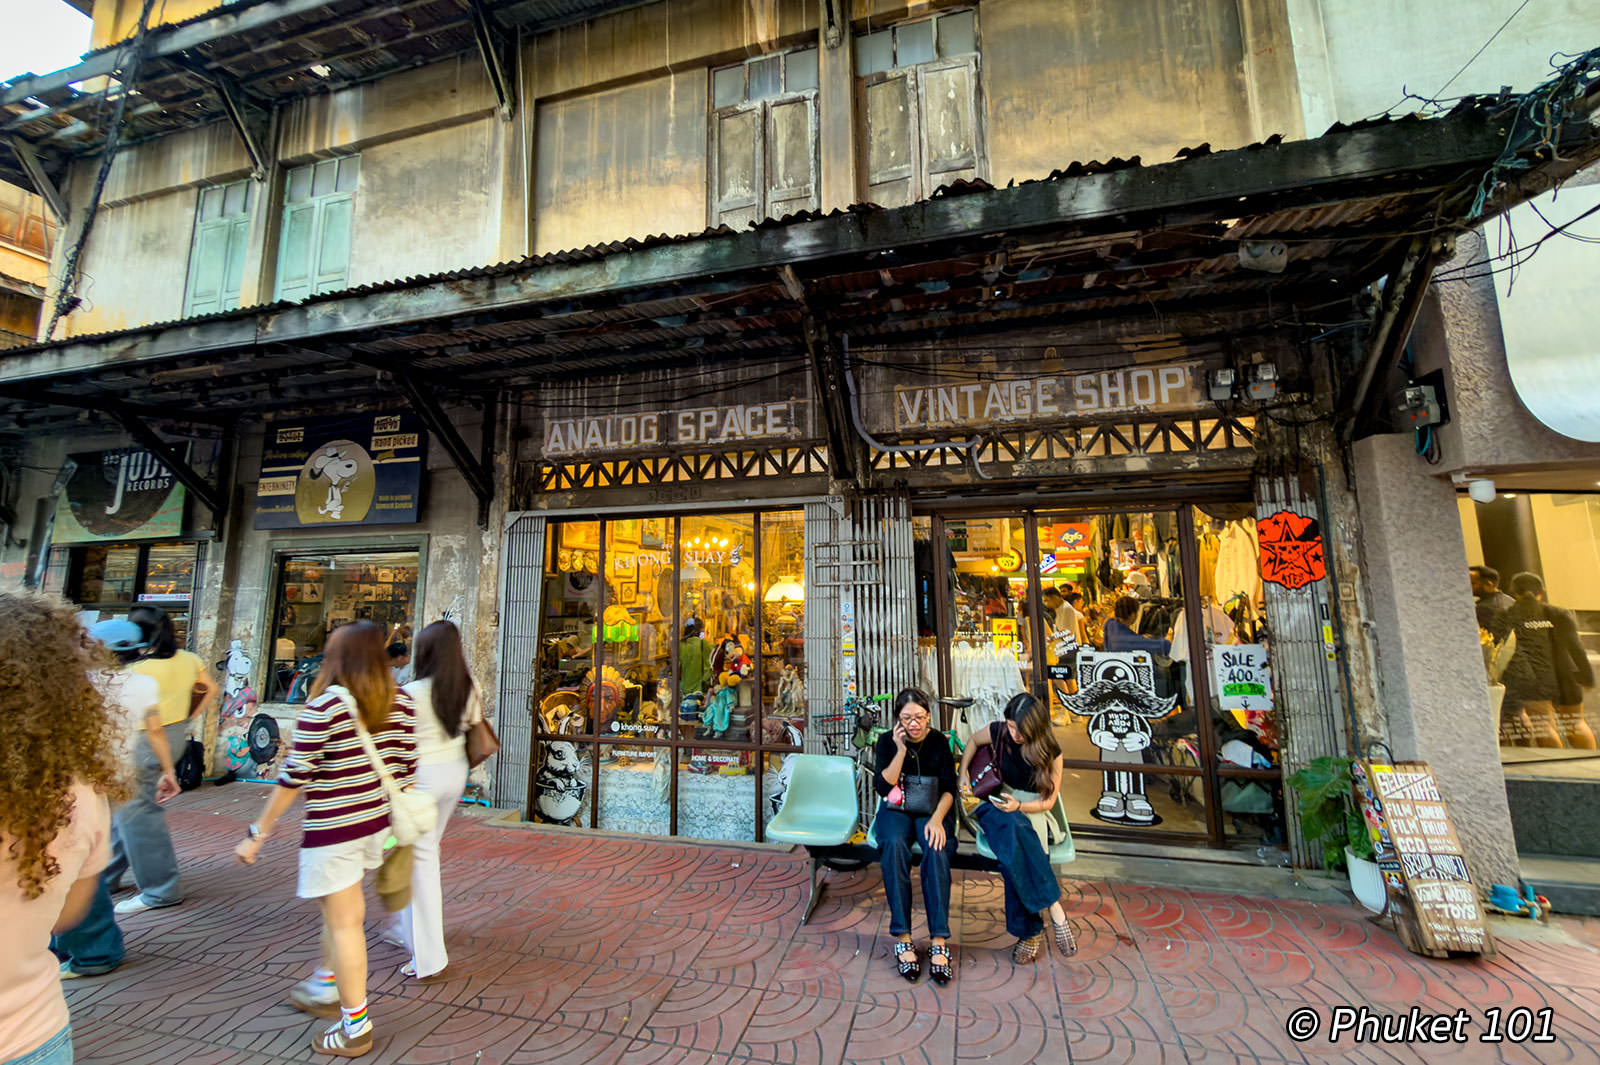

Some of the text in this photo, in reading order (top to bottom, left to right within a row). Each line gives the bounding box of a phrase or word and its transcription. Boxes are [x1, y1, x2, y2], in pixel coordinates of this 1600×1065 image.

[899, 367, 1185, 424] VINTAGE SHOP
[548, 404, 788, 451] ANALOG SPACE
[126, 478, 170, 492] RECORDS
[613, 551, 725, 570] KHONG SUAY
[1221, 651, 1255, 668] SALE
[1050, 666, 1069, 674] PUSH
[1228, 668, 1253, 684] 400
[620, 722, 659, 734] khong.suay
[1384, 802, 1414, 817] FILM
[1390, 818, 1420, 834] FILM
